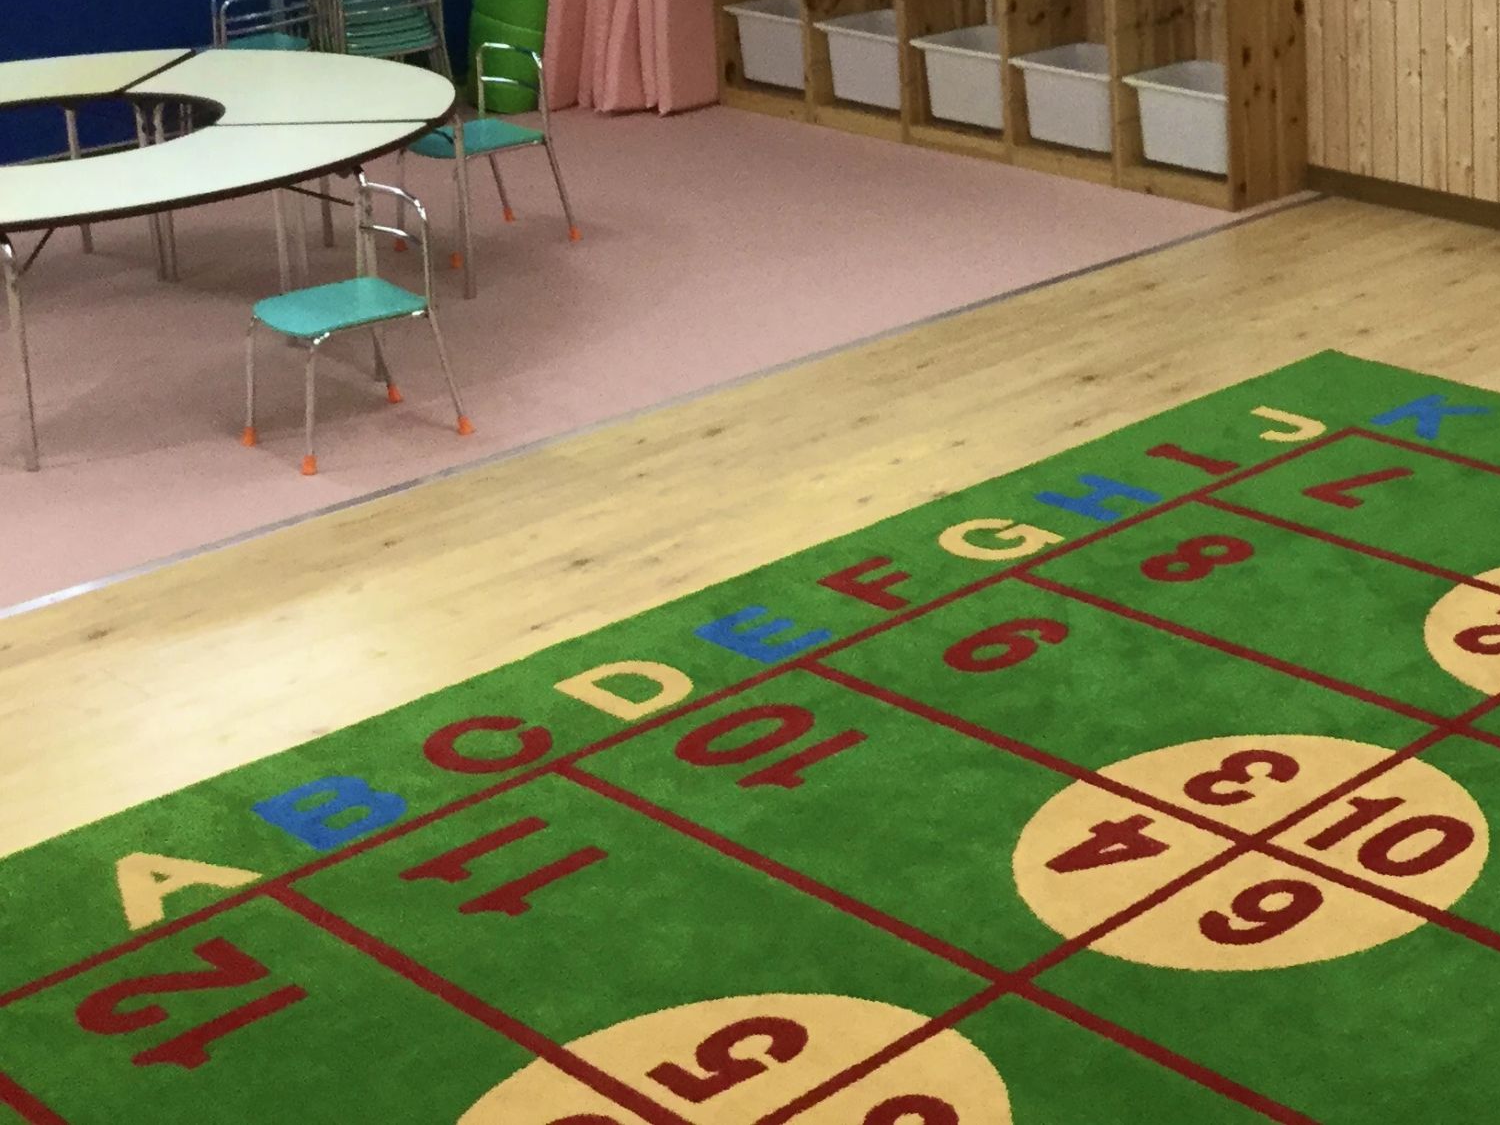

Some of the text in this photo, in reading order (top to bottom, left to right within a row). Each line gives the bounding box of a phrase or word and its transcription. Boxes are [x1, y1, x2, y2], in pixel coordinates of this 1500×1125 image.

[1370, 394, 1492, 439] K
[1140, 535, 1254, 582] 8
[115, 852, 263, 930] A
[250, 776, 407, 851] B
[423, 716, 553, 773] C
[553, 660, 693, 720] D
[695, 606, 831, 663] E
[818, 556, 912, 609] F
[938, 518, 1065, 560] G
[1034, 475, 1162, 521] H
[1251, 406, 1326, 442] J
[675, 704, 868, 788] 10
[1183, 749, 1300, 807] 3
[400, 817, 607, 916] 11
[1045, 814, 1170, 873] 4
[1304, 796, 1475, 877] 10
[1199, 879, 1325, 945] 9
[75, 937, 308, 1069] 12
[645, 1016, 809, 1103] 5
